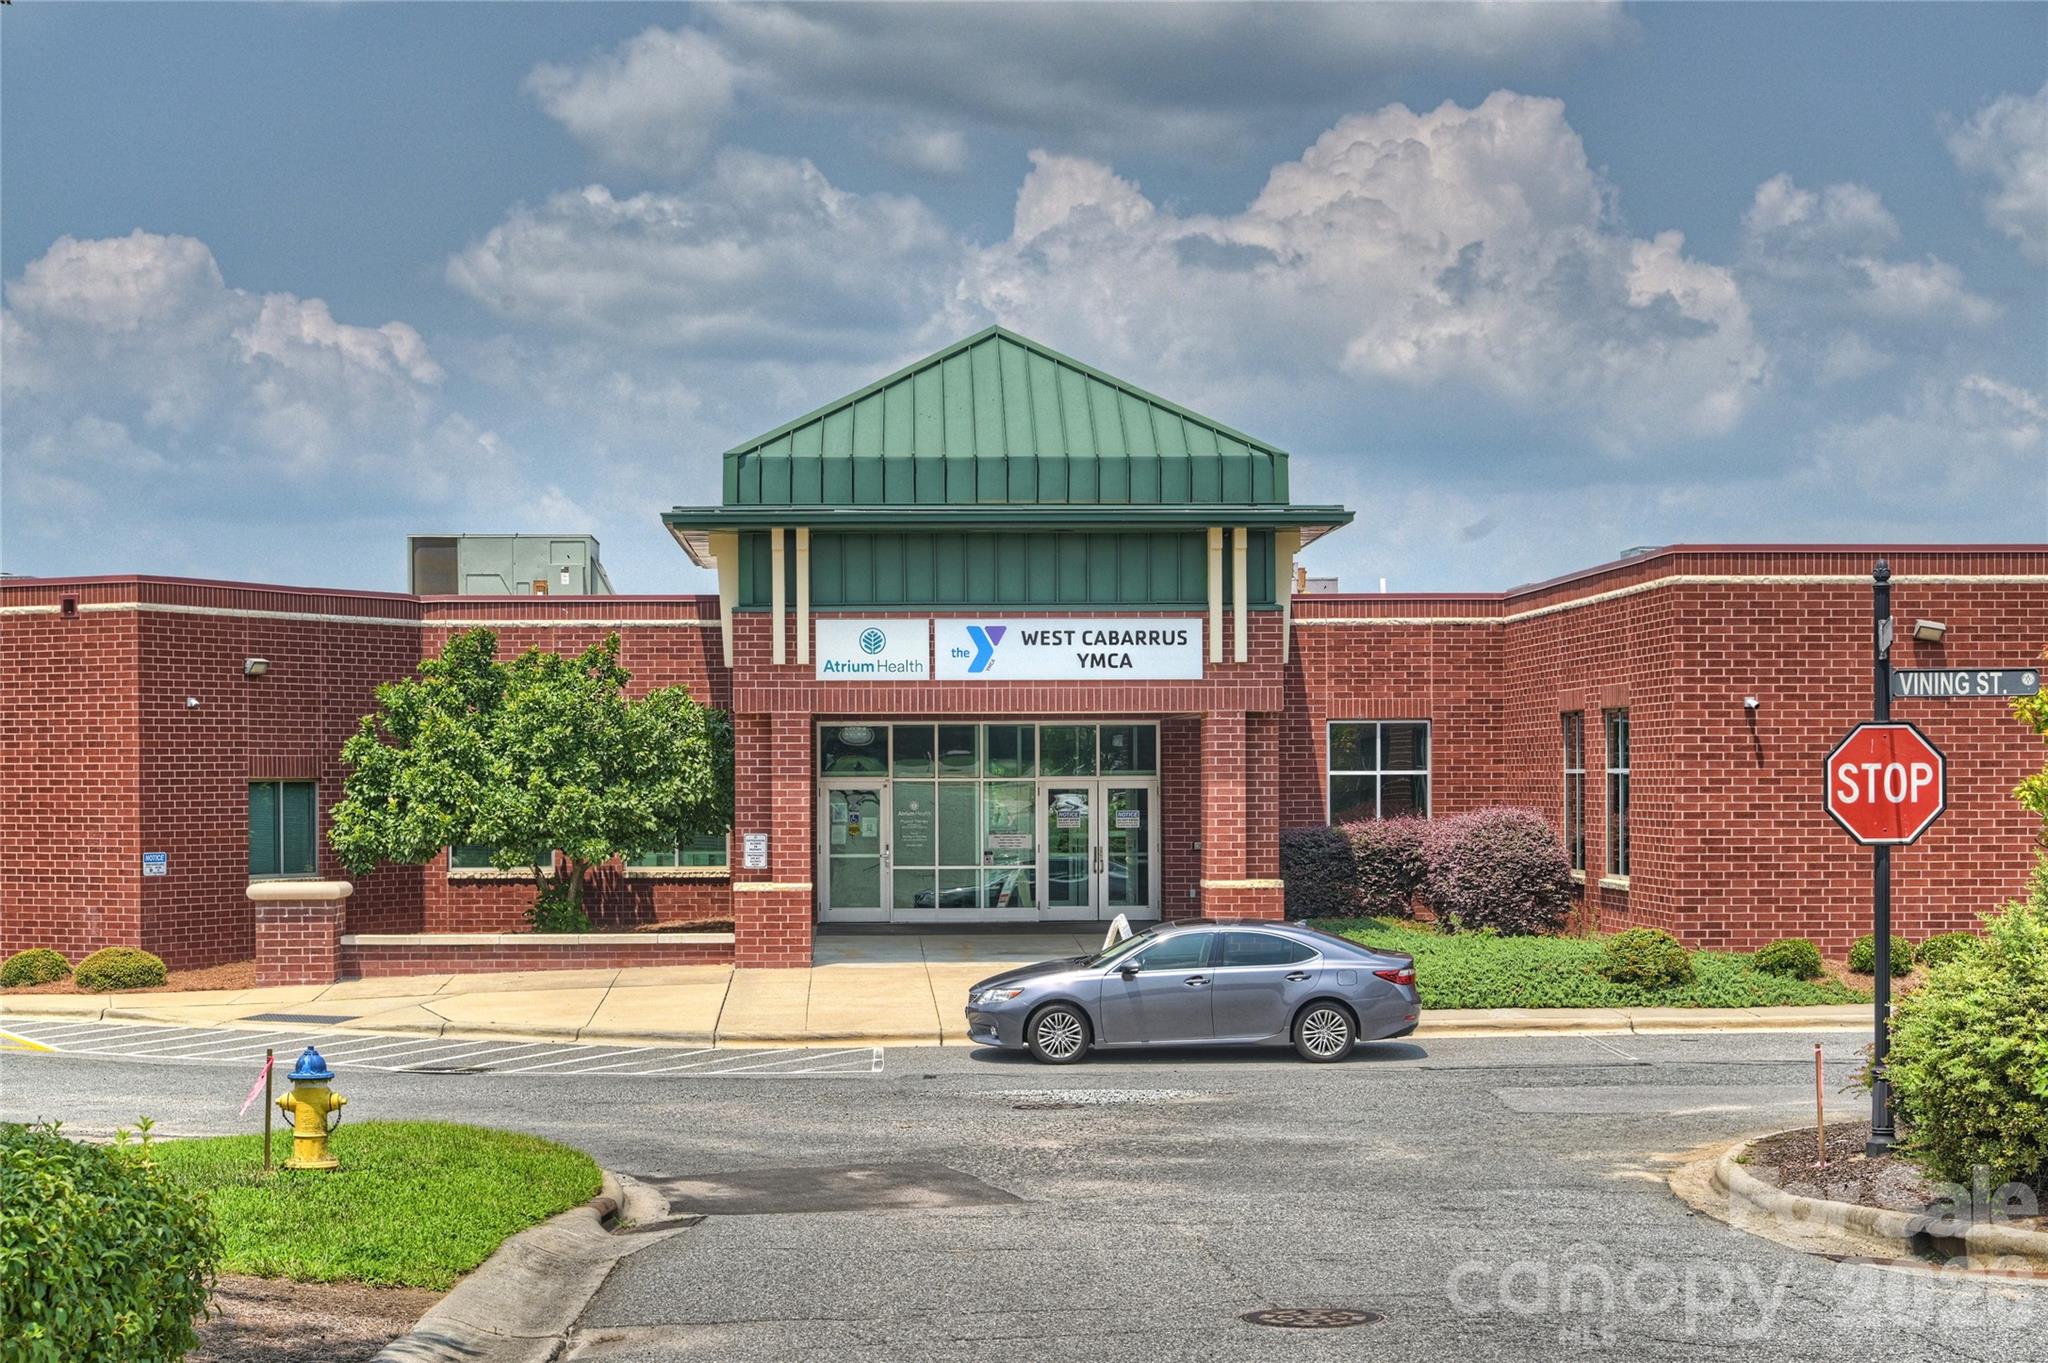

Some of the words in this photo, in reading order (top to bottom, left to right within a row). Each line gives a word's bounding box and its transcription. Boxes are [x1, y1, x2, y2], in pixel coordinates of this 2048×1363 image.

[1021, 630, 1076, 646] WEST
[1082, 630, 1188, 646] CABARRUS
[951, 648, 970, 658] the
[1077, 653, 1133, 669] YMCA
[823, 660, 875, 673] Atrium
[877, 659, 924, 673] Health
[1900, 671, 1970, 695] VINING
[1976, 671, 2008, 695] ST.
[1837, 762, 1933, 804] STOP
